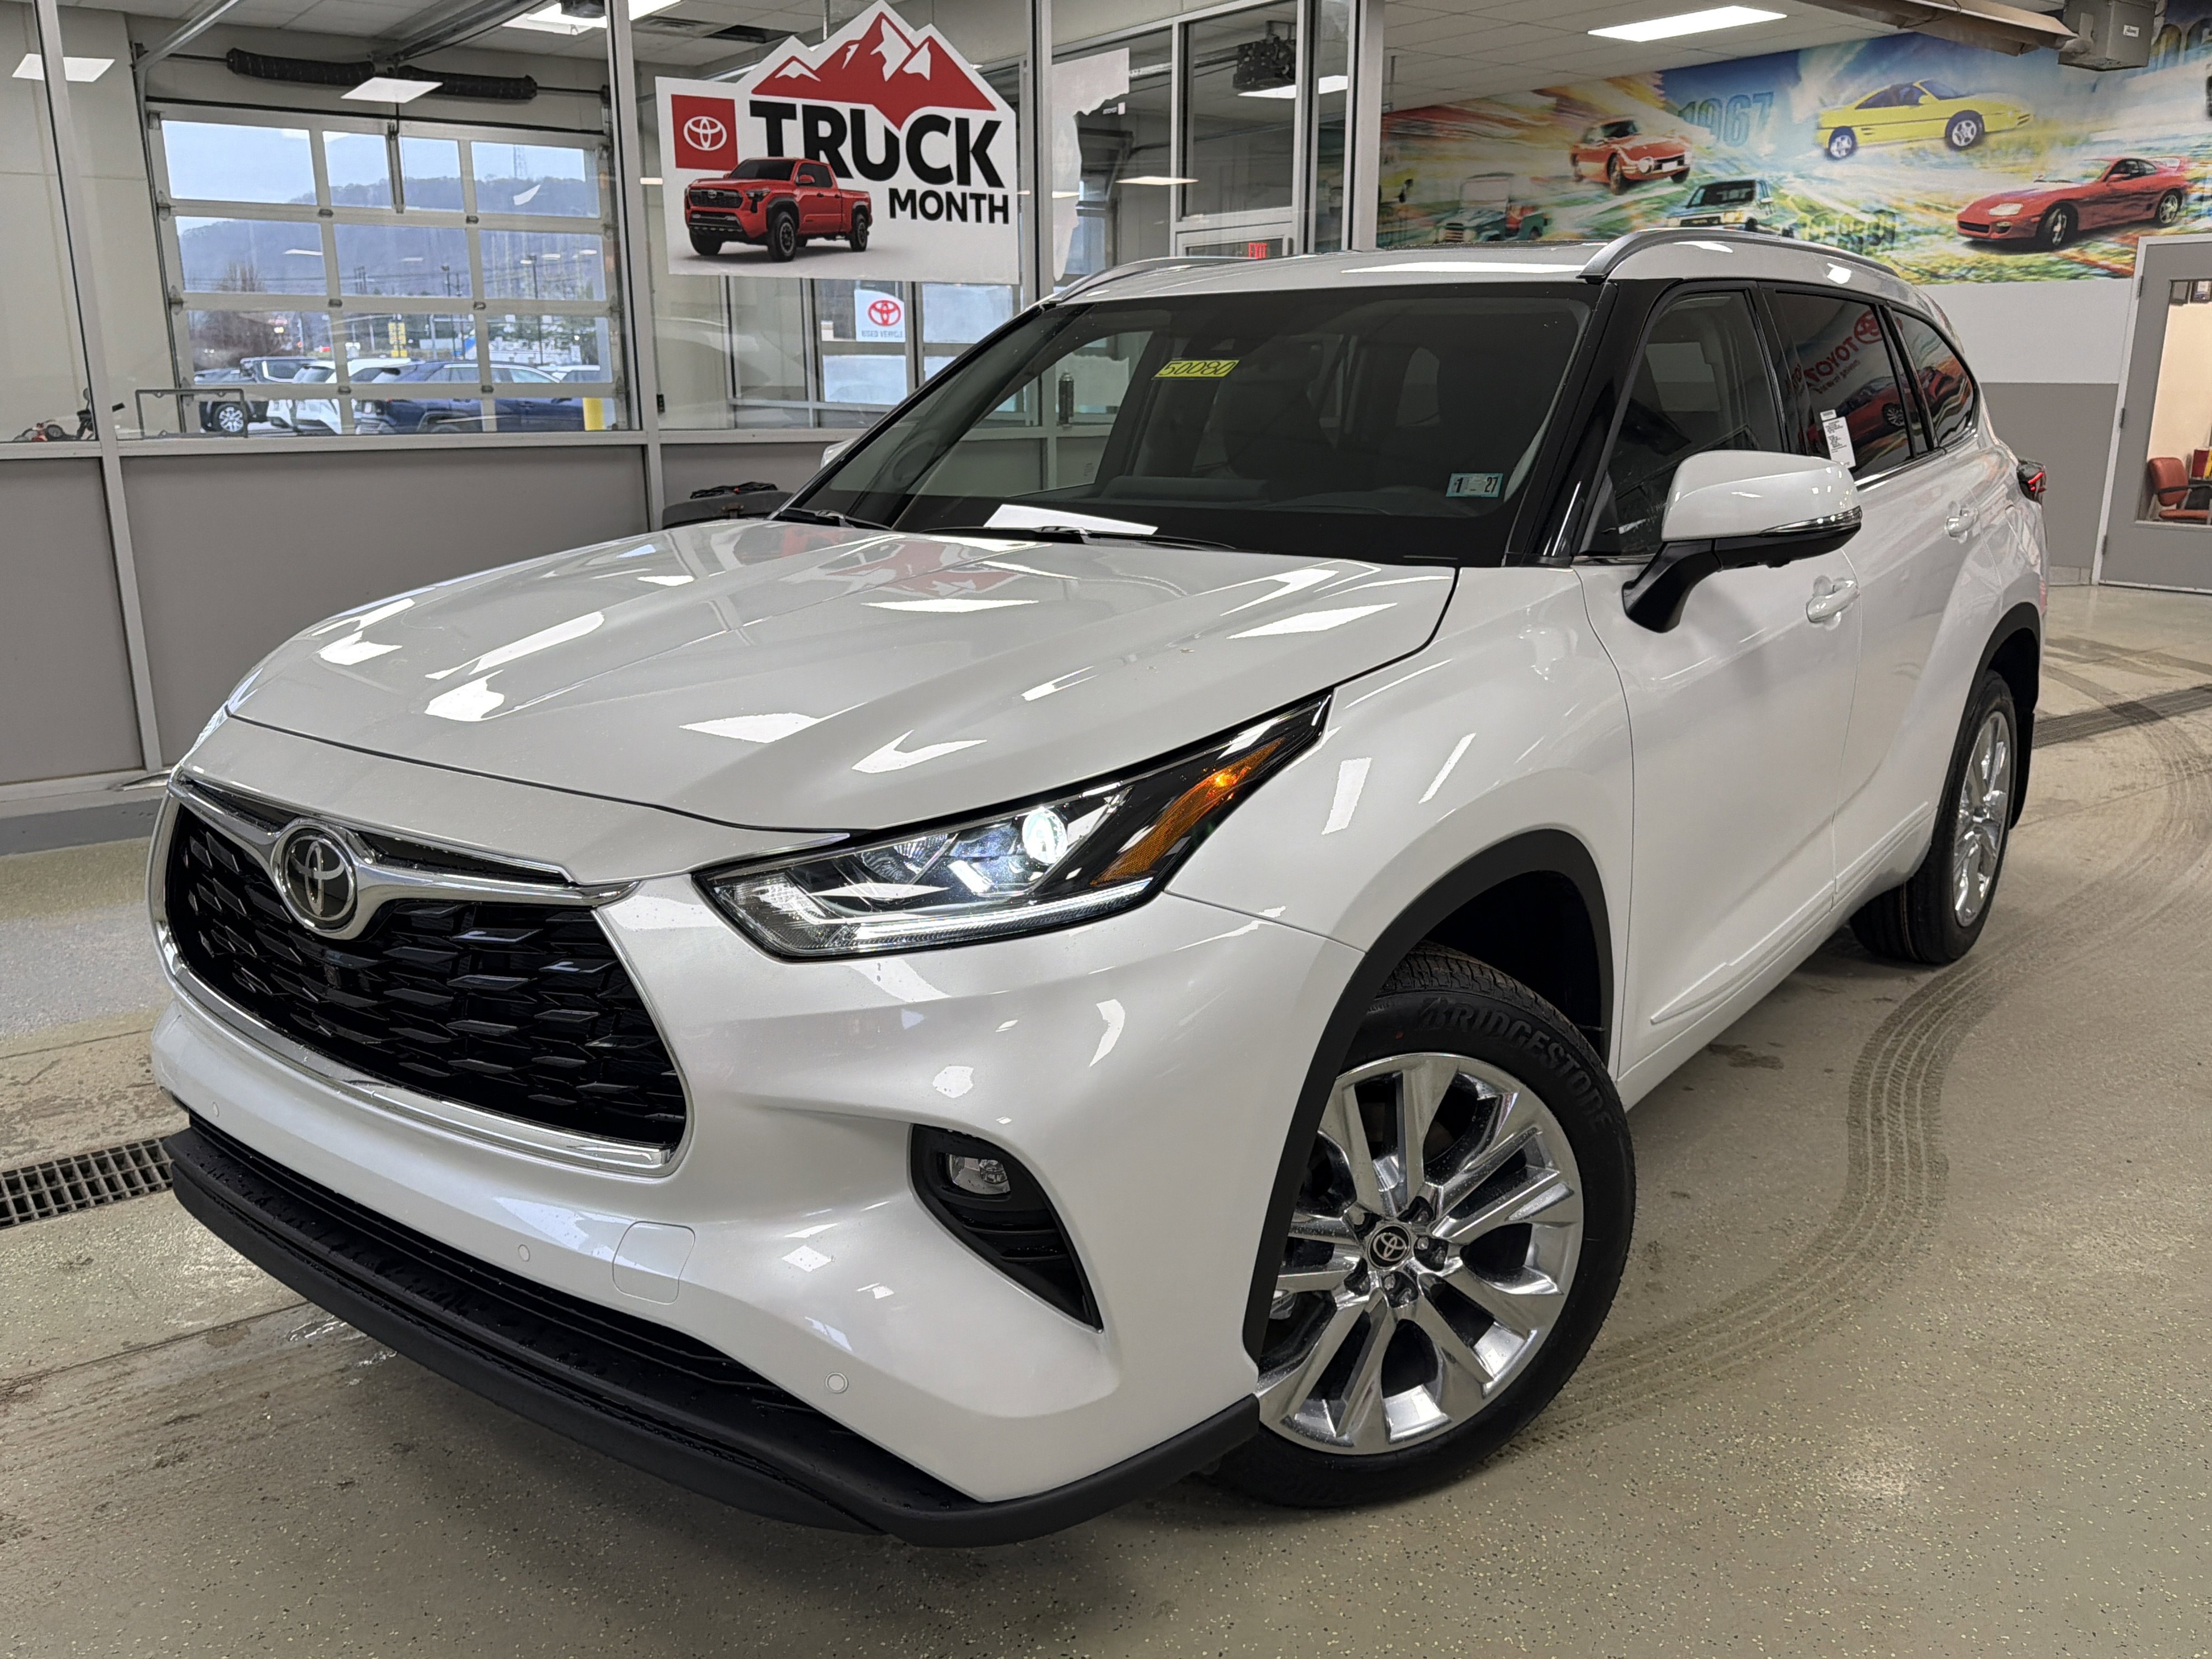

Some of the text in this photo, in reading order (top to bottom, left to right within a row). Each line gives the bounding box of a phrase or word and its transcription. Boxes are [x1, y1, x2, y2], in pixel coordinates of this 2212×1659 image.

[749, 100, 1005, 189] TRUCK
[888, 188, 1009, 225] MONTH
[1248, 242, 1267, 259] EXIT
[1159, 361, 1237, 375] 50080
[1484, 476, 1499, 493] 27
[1419, 996, 1613, 1132] BRIDGESTONE
